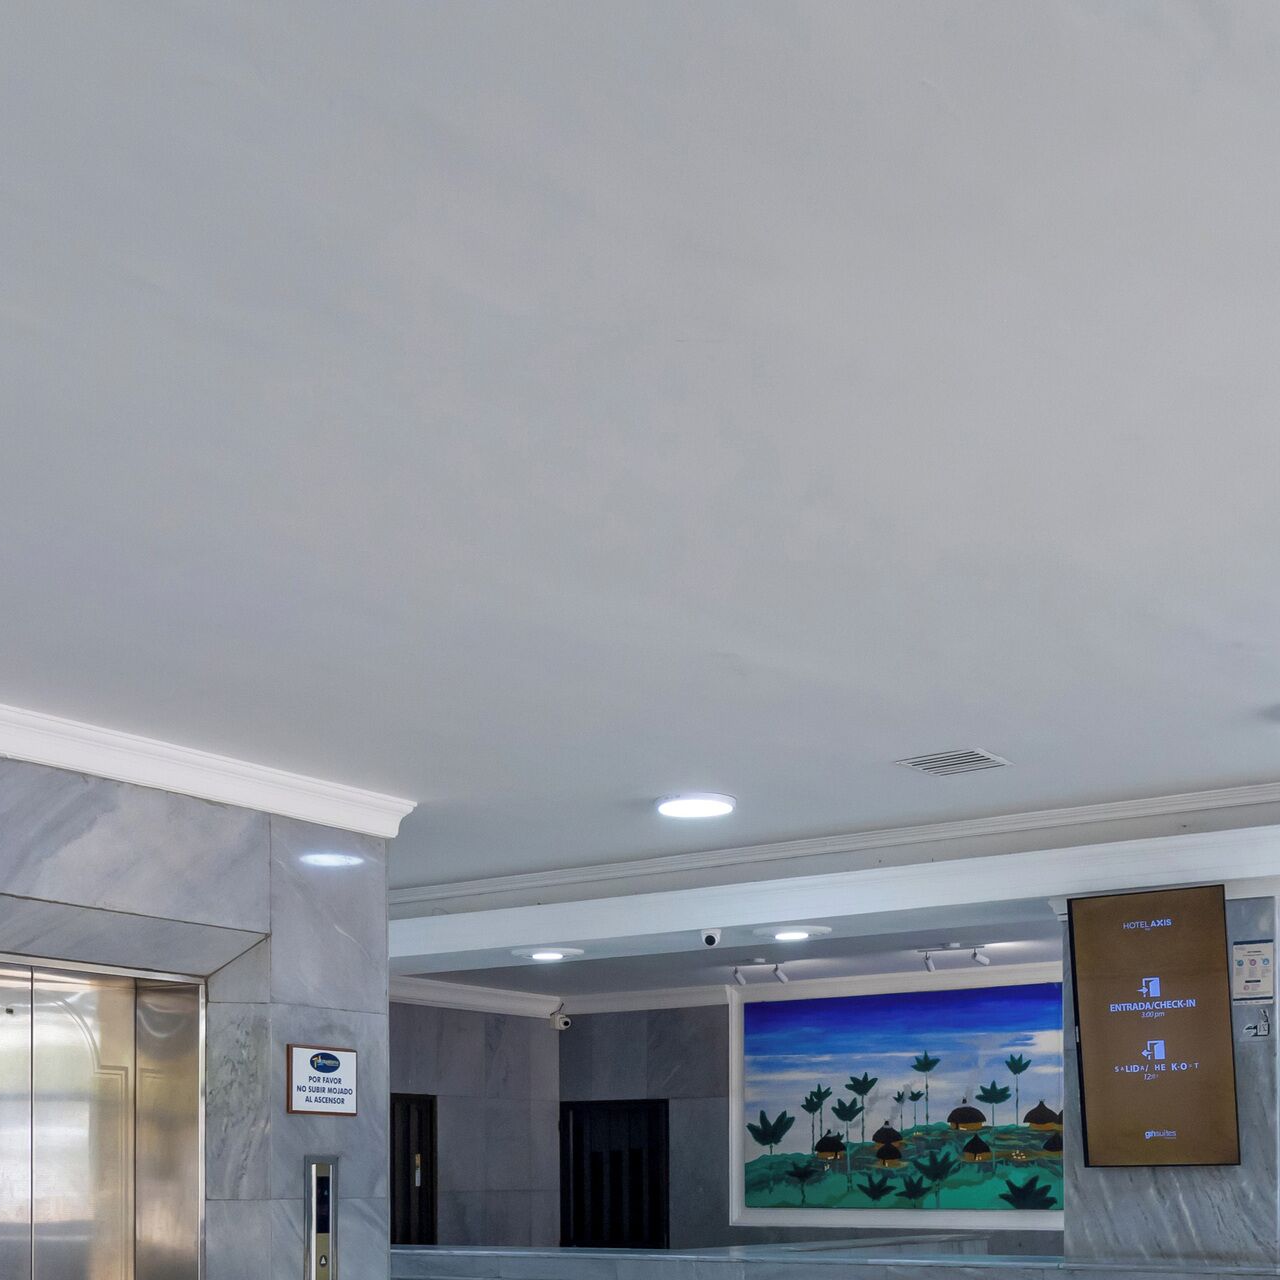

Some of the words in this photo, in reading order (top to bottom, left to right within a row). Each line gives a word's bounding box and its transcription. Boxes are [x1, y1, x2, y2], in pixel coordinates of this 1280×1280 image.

[1123, 921, 1150, 929] HOTEL
[1150, 919, 1172, 927] AXIS
[1110, 999, 1196, 1012] ENTRADA/CHECK-IN
[296, 1085, 307, 1093] NO
[327, 1087, 353, 1095] MOJADO
